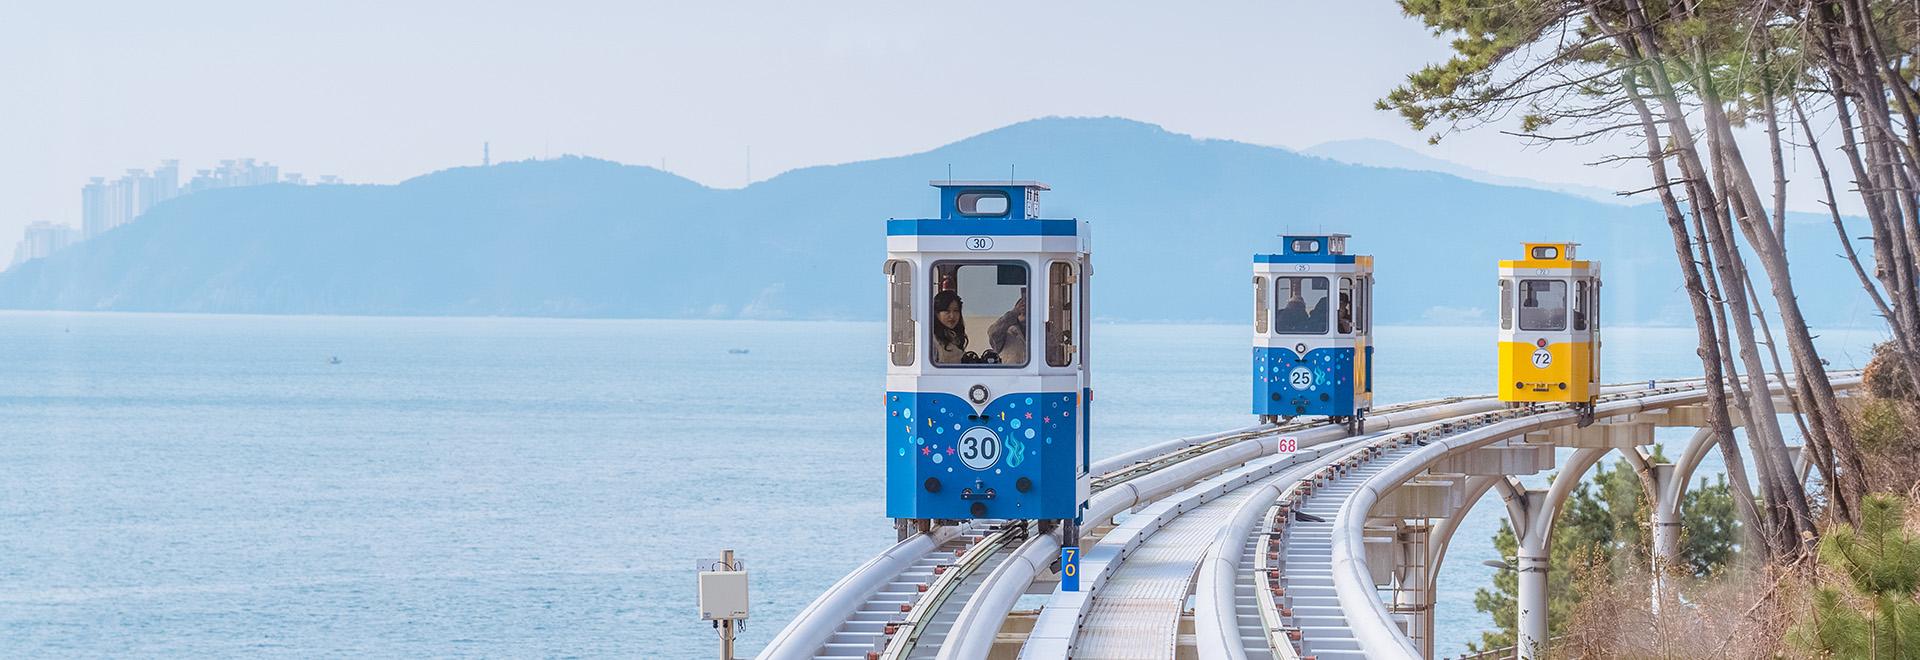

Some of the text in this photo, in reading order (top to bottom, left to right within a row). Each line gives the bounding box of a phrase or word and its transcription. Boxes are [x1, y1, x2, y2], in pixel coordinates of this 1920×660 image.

[973, 239, 986, 248] 30
[1534, 353, 1549, 364] 72
[1292, 372, 1309, 384] 25
[963, 437, 995, 459] 30
[1279, 439, 1295, 452] 68
[1065, 550, 1075, 576] 70
